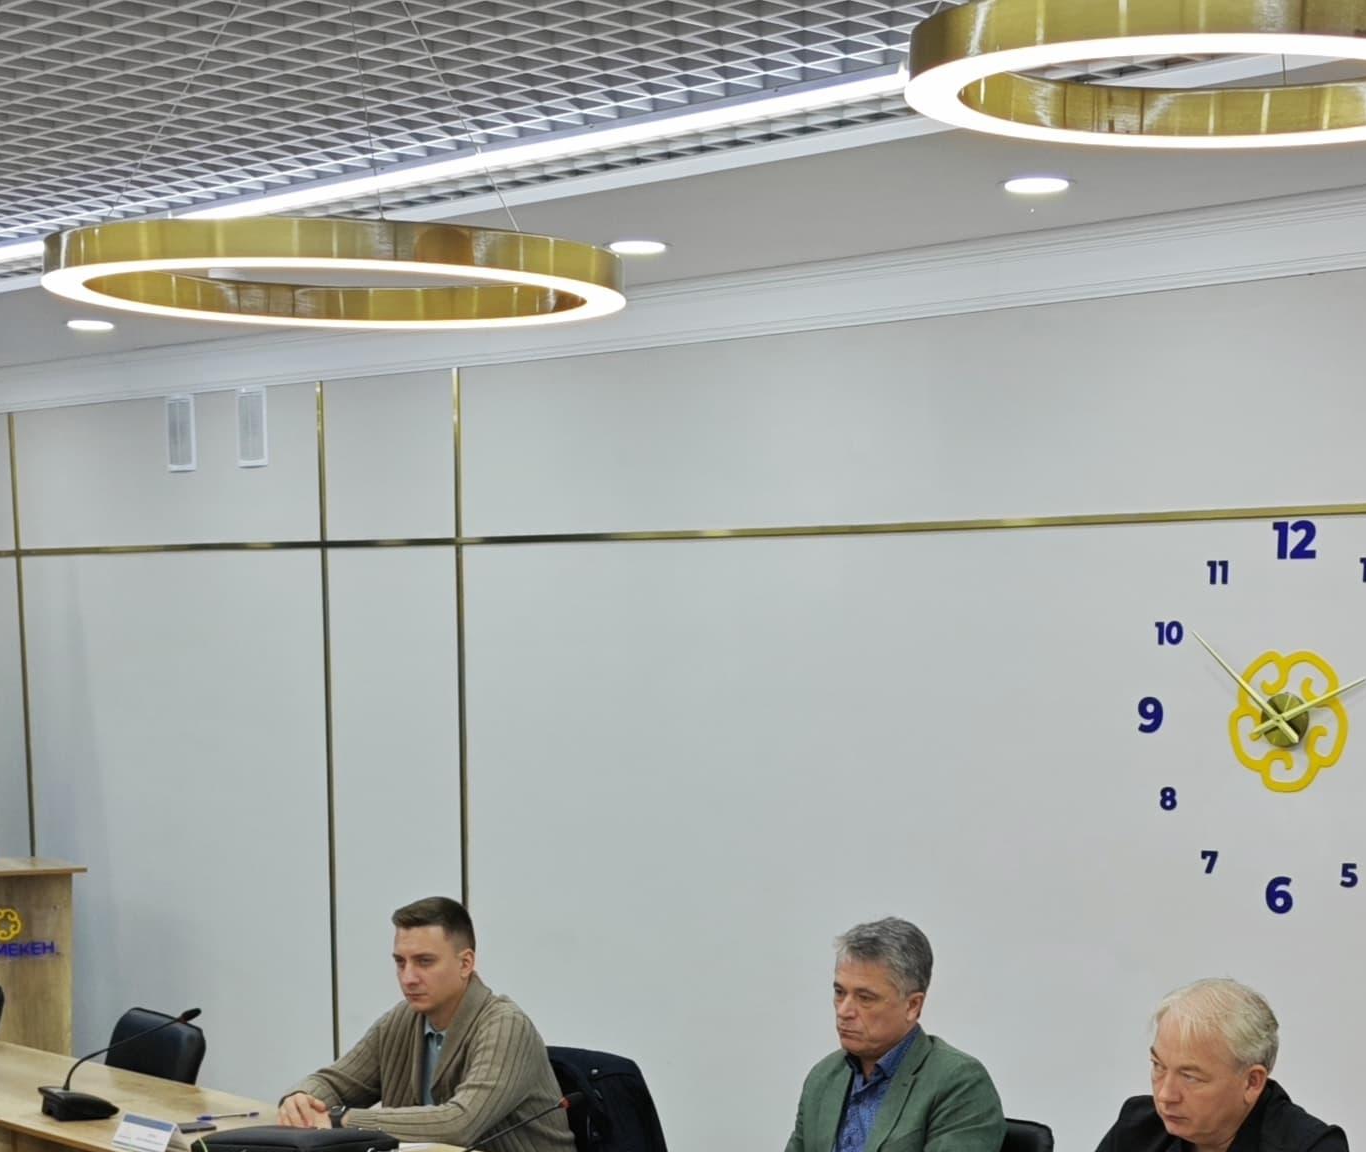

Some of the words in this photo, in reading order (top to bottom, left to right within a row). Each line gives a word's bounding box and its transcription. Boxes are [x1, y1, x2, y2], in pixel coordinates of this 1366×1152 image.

[1272, 519, 1317, 560] 12
[1206, 560, 1230, 585] 11
[1154, 620, 1184, 646] 10
[1137, 696, 1164, 733] 9
[1159, 786, 1178, 811] 8
[1199, 850, 1220, 874] 7
[1339, 863, 1359, 888] 5
[1264, 876, 1294, 914] 6
